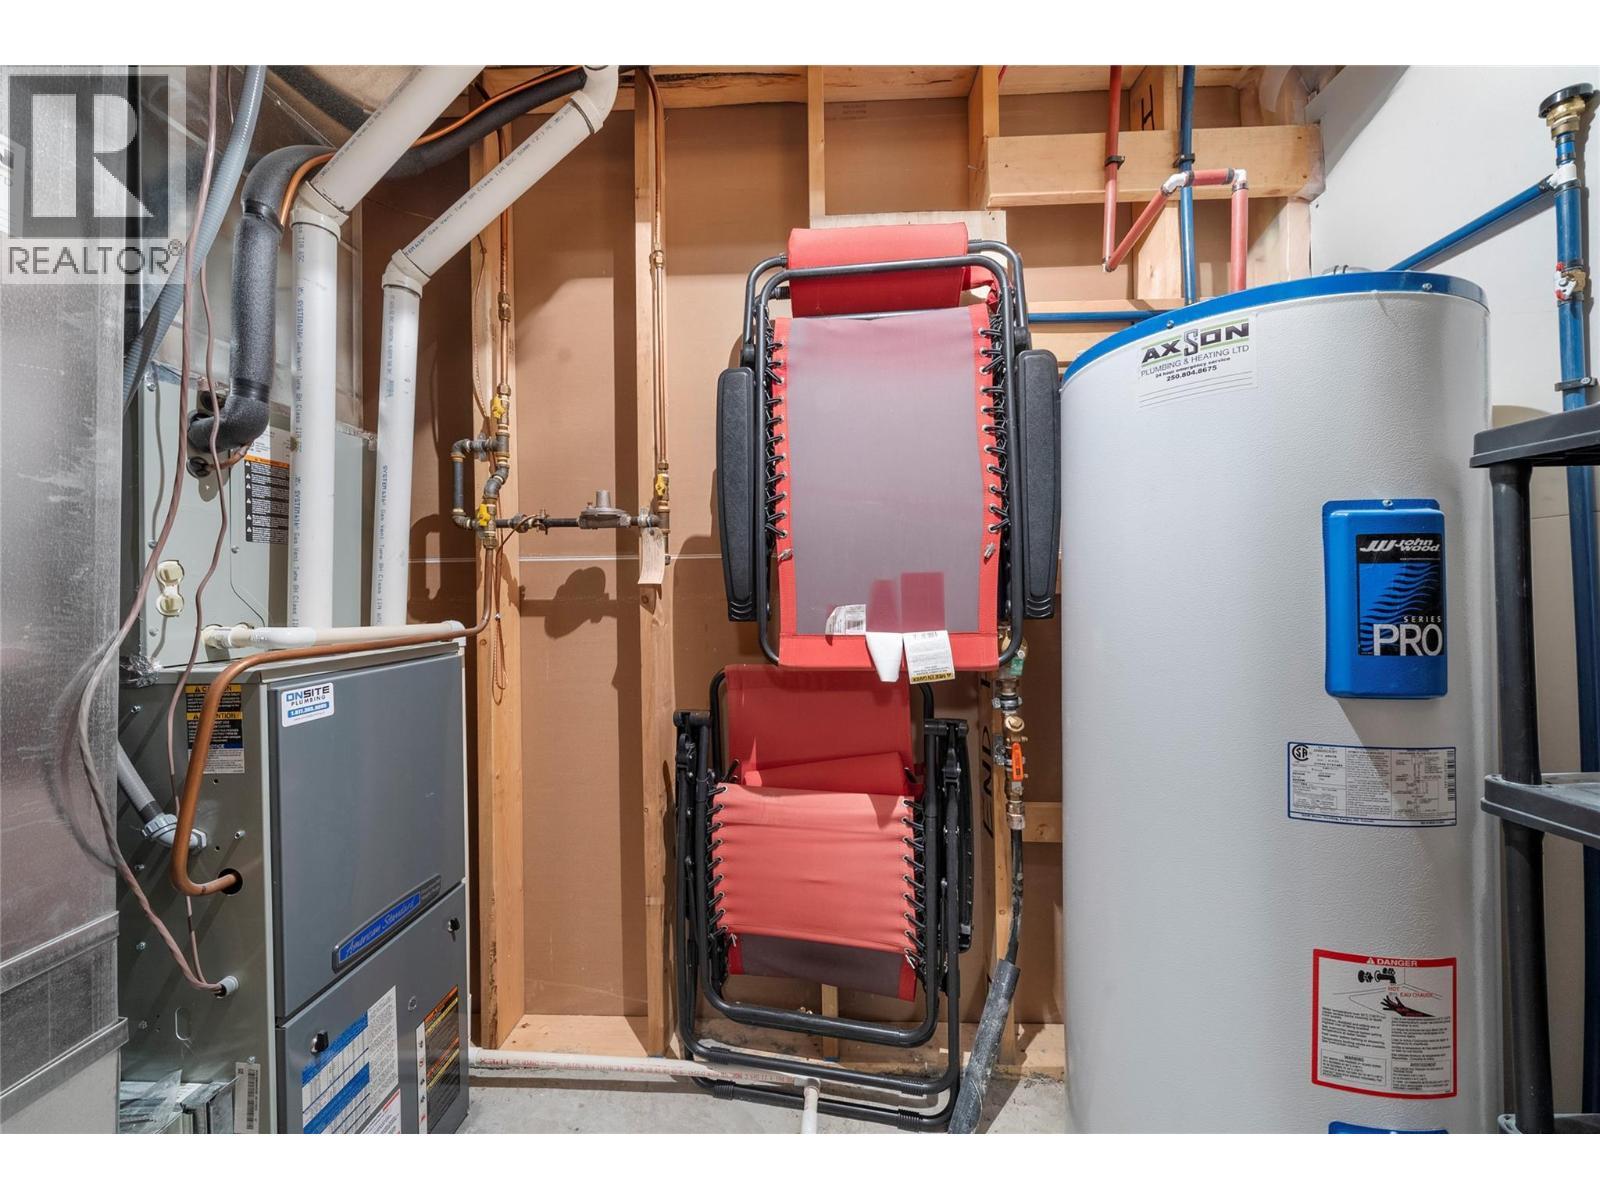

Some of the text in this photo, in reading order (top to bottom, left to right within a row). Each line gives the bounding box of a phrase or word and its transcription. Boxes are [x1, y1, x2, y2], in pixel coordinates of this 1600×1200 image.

[1141, 360, 1182, 376] PLUMBING
[1191, 348, 1230, 362] HEATING
[1232, 344, 1250, 354] LTD
[1373, 624, 1443, 656] PRO
[286, 686, 330, 702] ONSITE
[1376, 959, 1418, 967] DANGER
